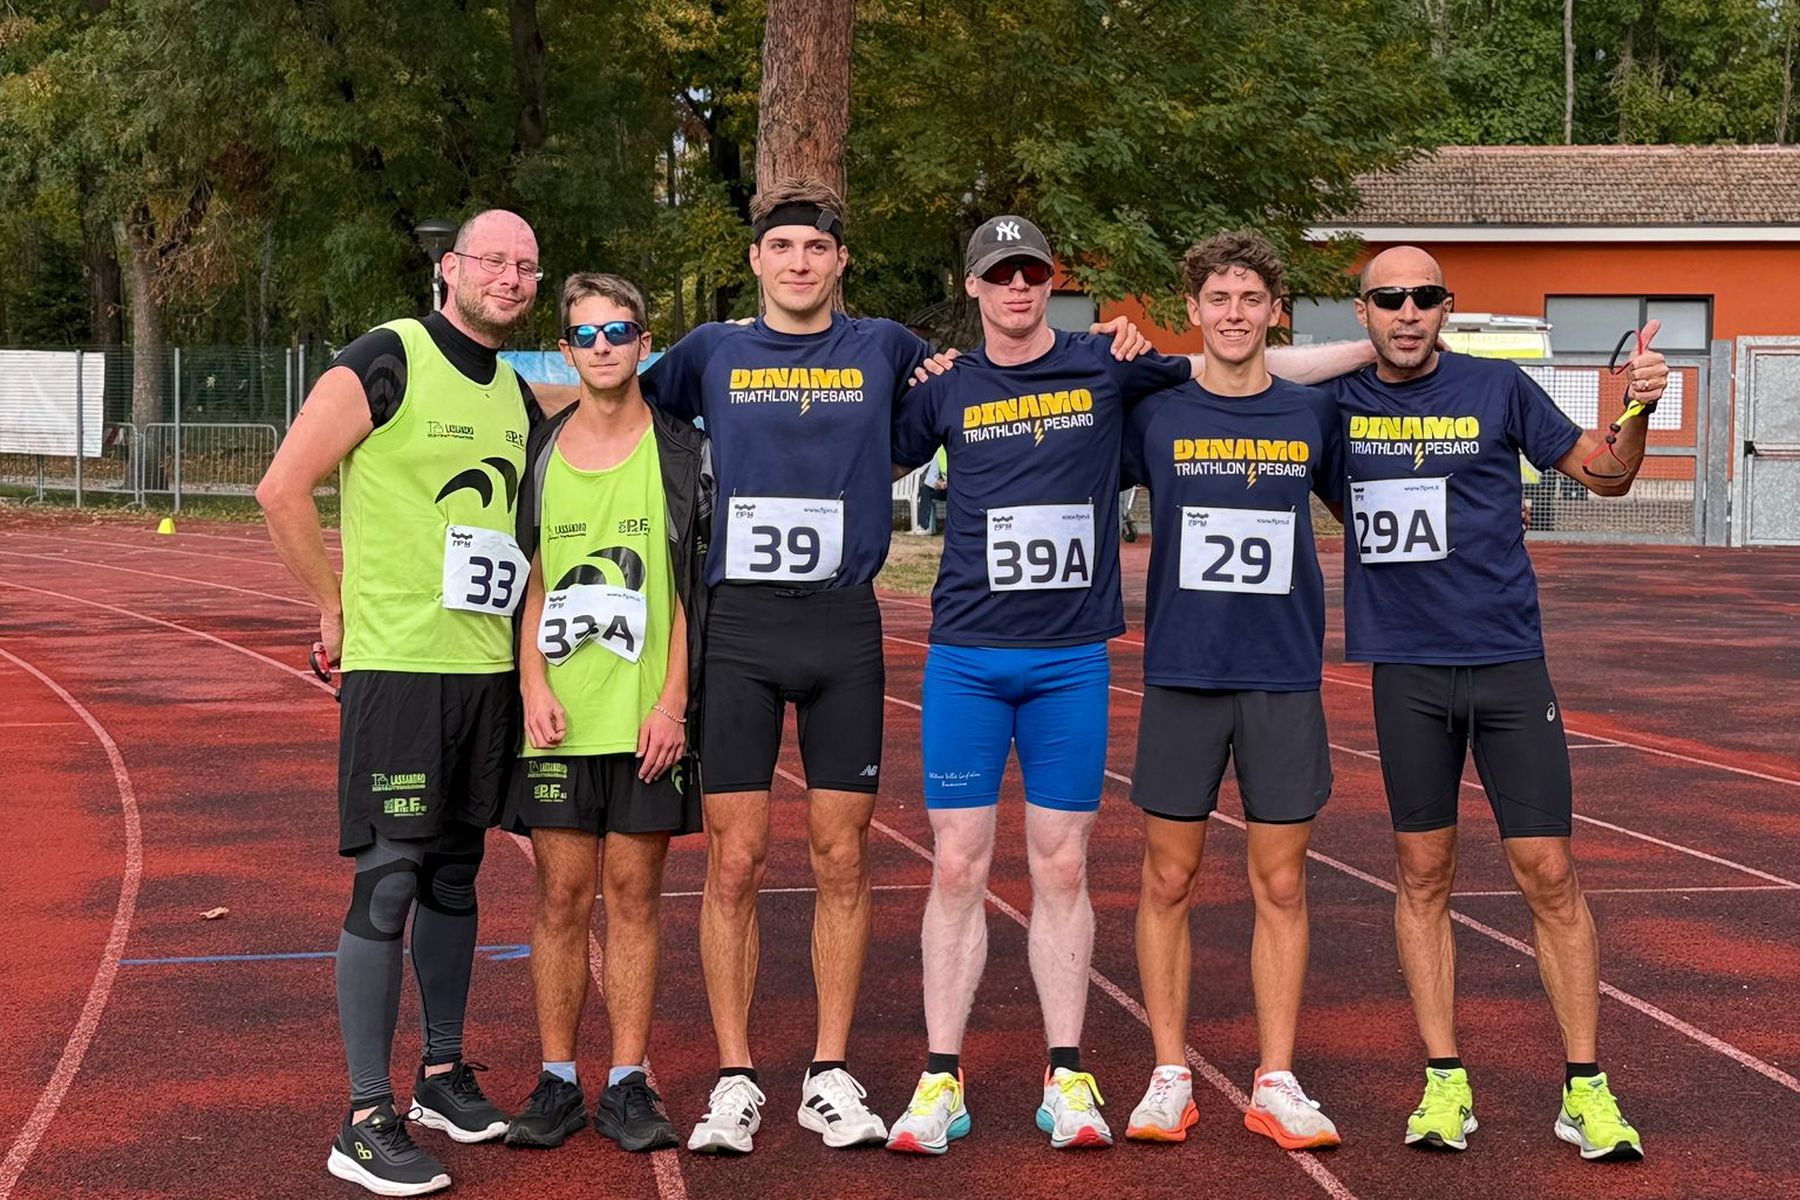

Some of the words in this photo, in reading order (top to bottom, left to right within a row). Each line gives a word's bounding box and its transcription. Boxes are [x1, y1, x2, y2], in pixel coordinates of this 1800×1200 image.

[995, 221, 1021, 241] NY
[729, 367, 864, 390] DINAMO
[729, 390, 799, 404] TRIATHLON
[811, 390, 864, 403] PESARO
[962, 388, 1093, 429] DINAMO
[963, 421, 1031, 443] TRIATHLON
[1043, 413, 1094, 431] PESARO
[1350, 416, 1480, 440] DINAMO
[1173, 438, 1309, 462] DINAMO
[1350, 441, 1412, 455] TRIATHLON
[1425, 441, 1480, 455] PESARO
[1173, 462, 1245, 476] TRIATHLON
[1258, 463, 1307, 478] PESARO
[1355, 509, 1442, 555] 29A
[749, 525, 821, 574] 39
[993, 538, 1089, 586] 39A
[1202, 534, 1272, 585] 29
[466, 556, 517, 609] 33
